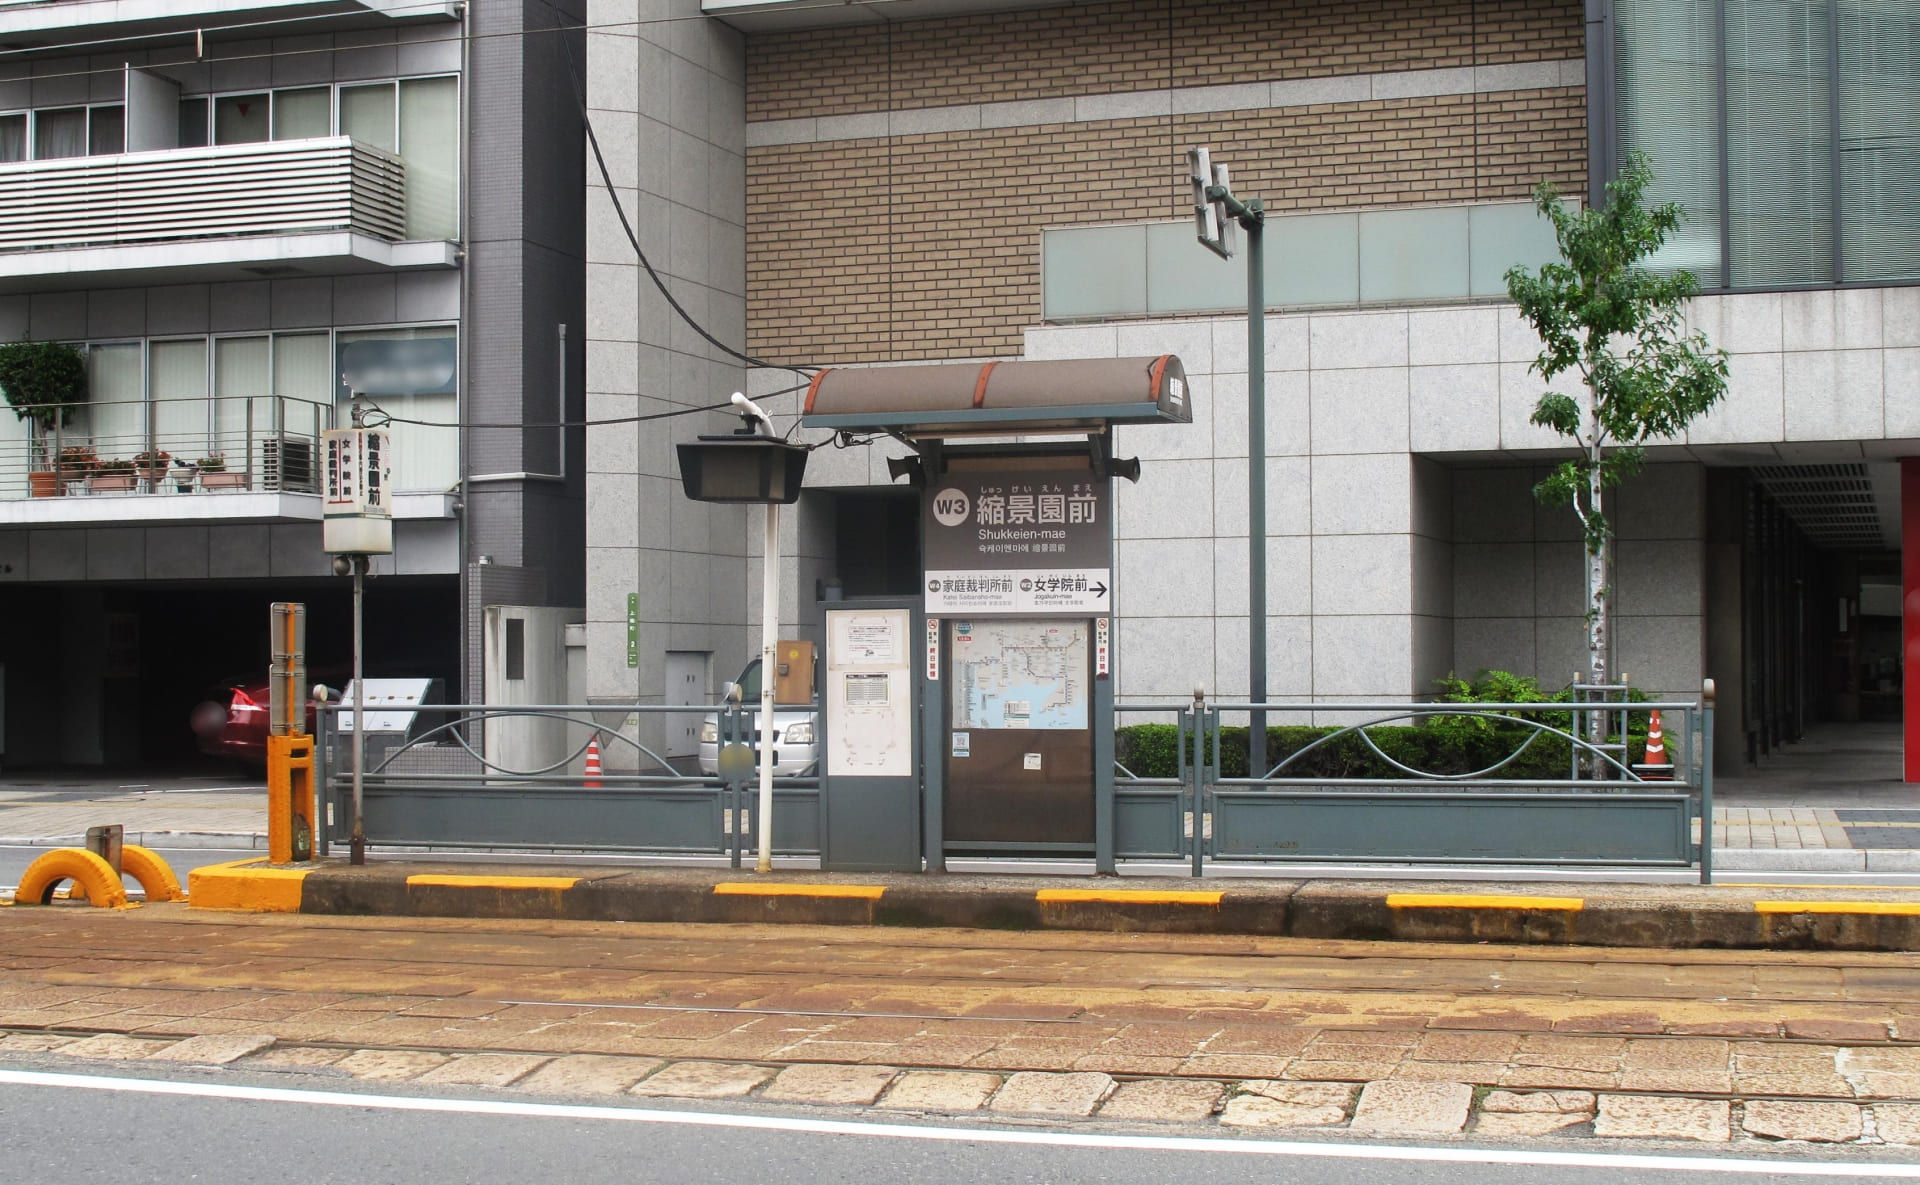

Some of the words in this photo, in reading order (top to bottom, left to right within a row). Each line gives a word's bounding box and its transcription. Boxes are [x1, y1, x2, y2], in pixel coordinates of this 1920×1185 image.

[1011, 485, 1032, 493] けい
[1041, 484, 1062, 493] えん
[1072, 483, 1093, 492] まえ
[936, 498, 966, 515] W3
[976, 493, 1097, 525] 縮景園前
[978, 528, 1066, 540] Shukkeien-mae
[942, 578, 1013, 593] 家庭裁判所前
[1034, 578, 1088, 592] 女学院前
